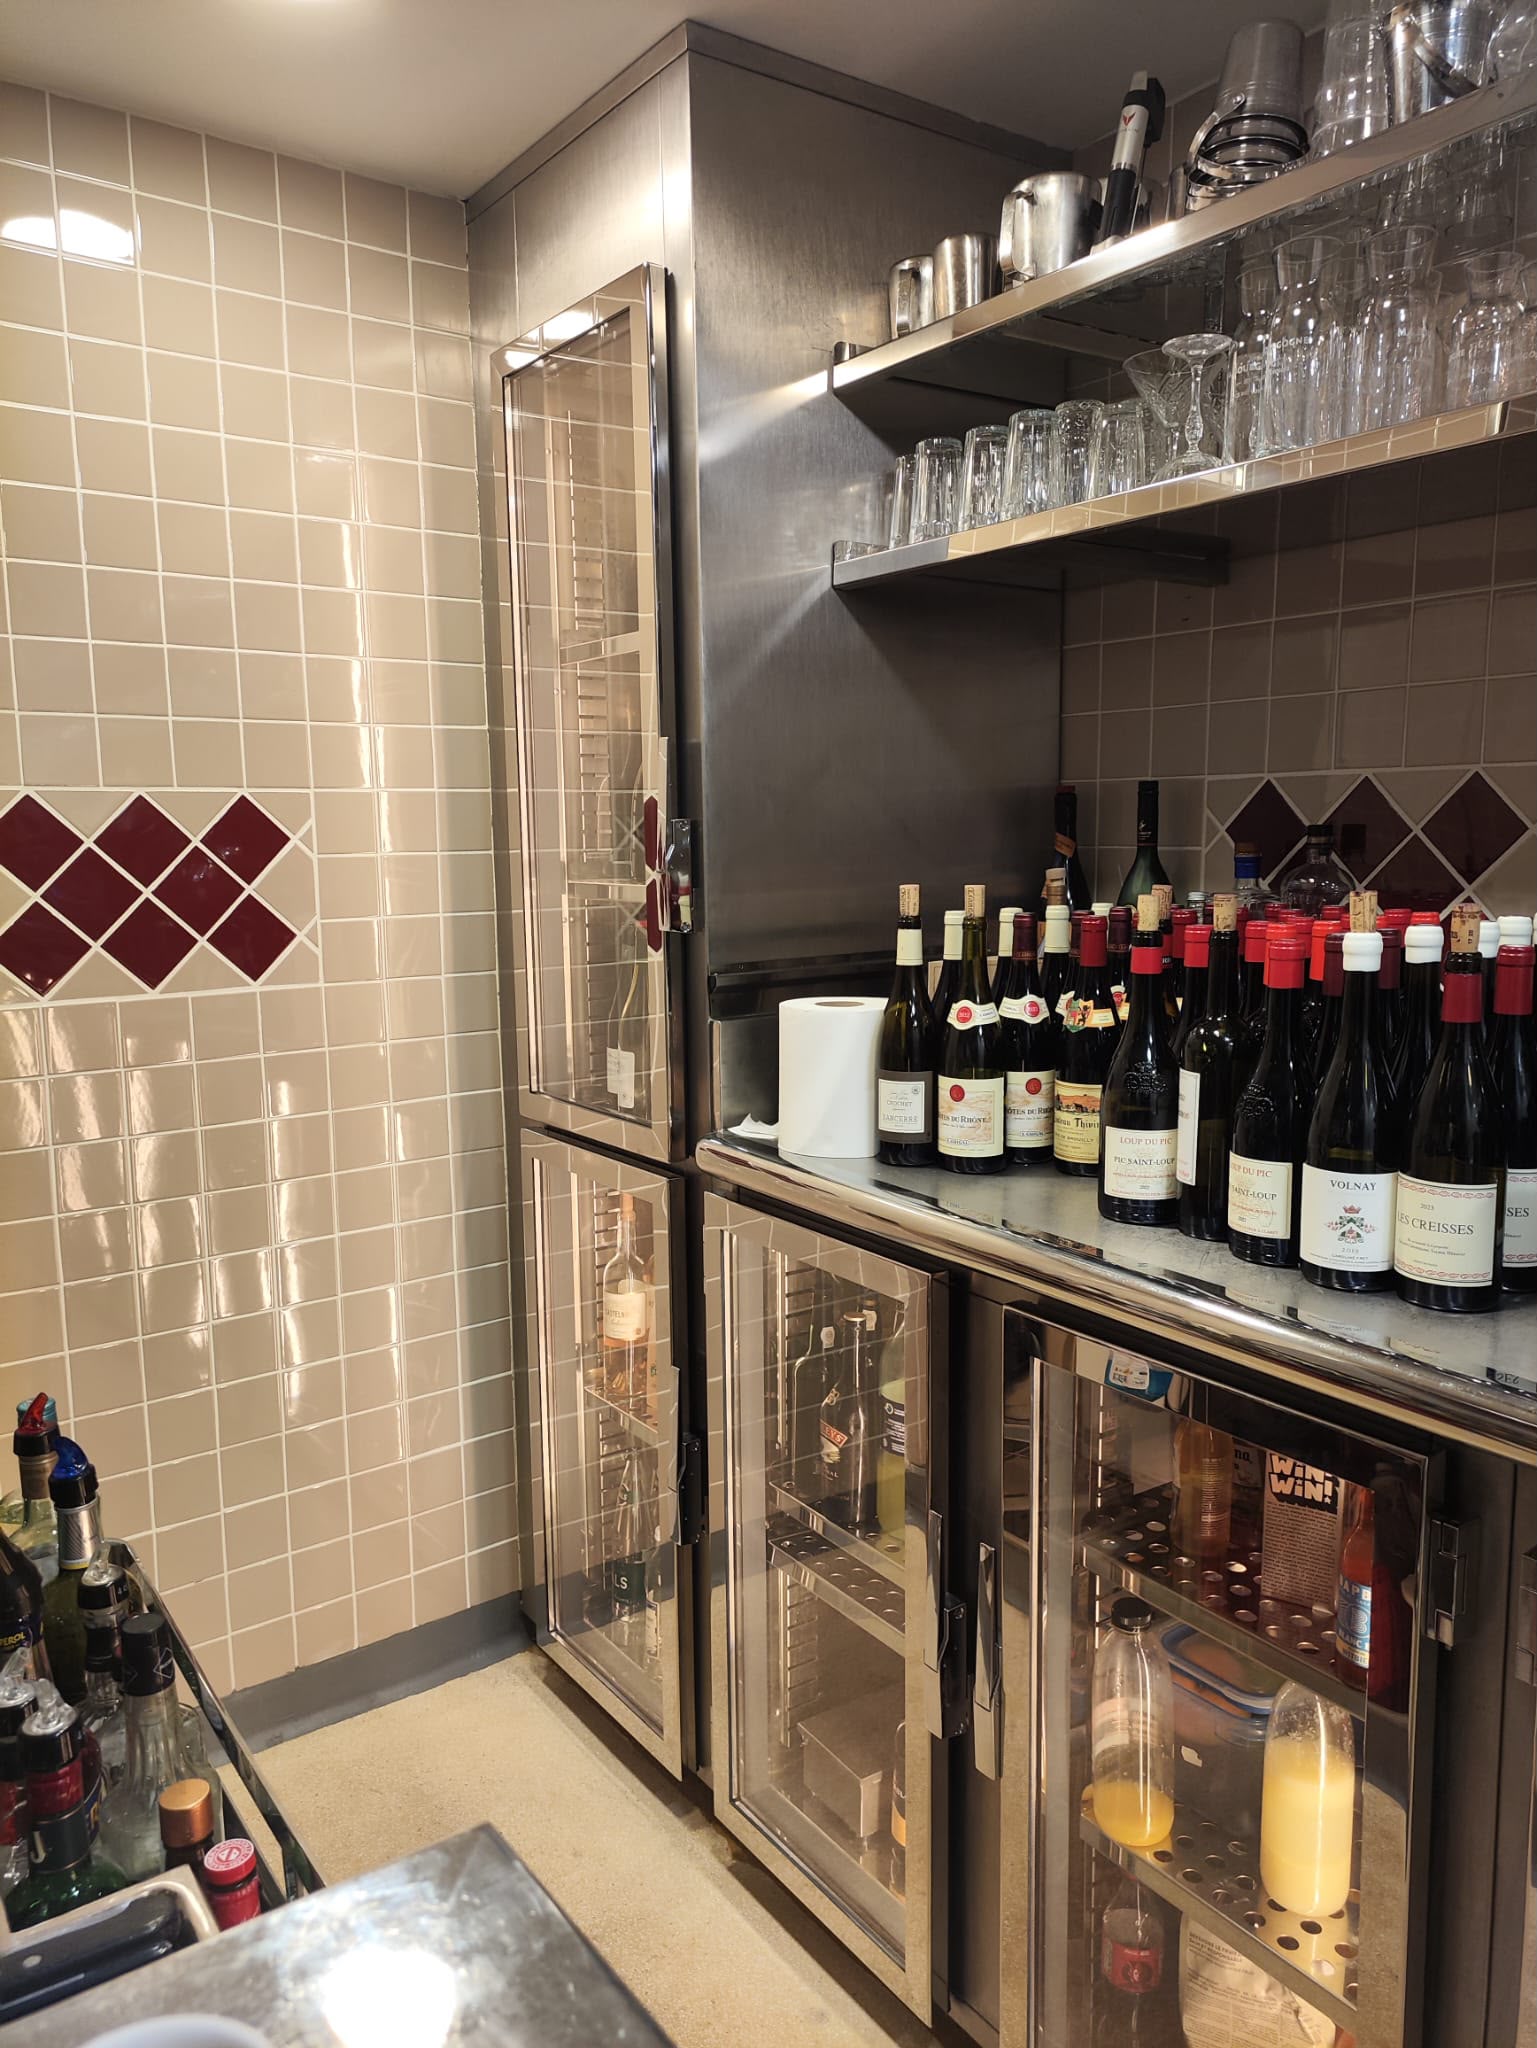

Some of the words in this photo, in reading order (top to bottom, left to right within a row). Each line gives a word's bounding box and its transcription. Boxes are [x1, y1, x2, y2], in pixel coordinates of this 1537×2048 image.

[1120, 1136, 1143, 1145] LOUP
[1160, 1137, 1173, 1145] PIC
[1114, 1156, 1127, 1164] PIC
[1243, 1166, 1255, 1175] DU
[1256, 1167, 1272, 1178] PIC
[1330, 1179, 1377, 1191] VOLNAY
[1411, 1217, 1474, 1235] CREISSES
